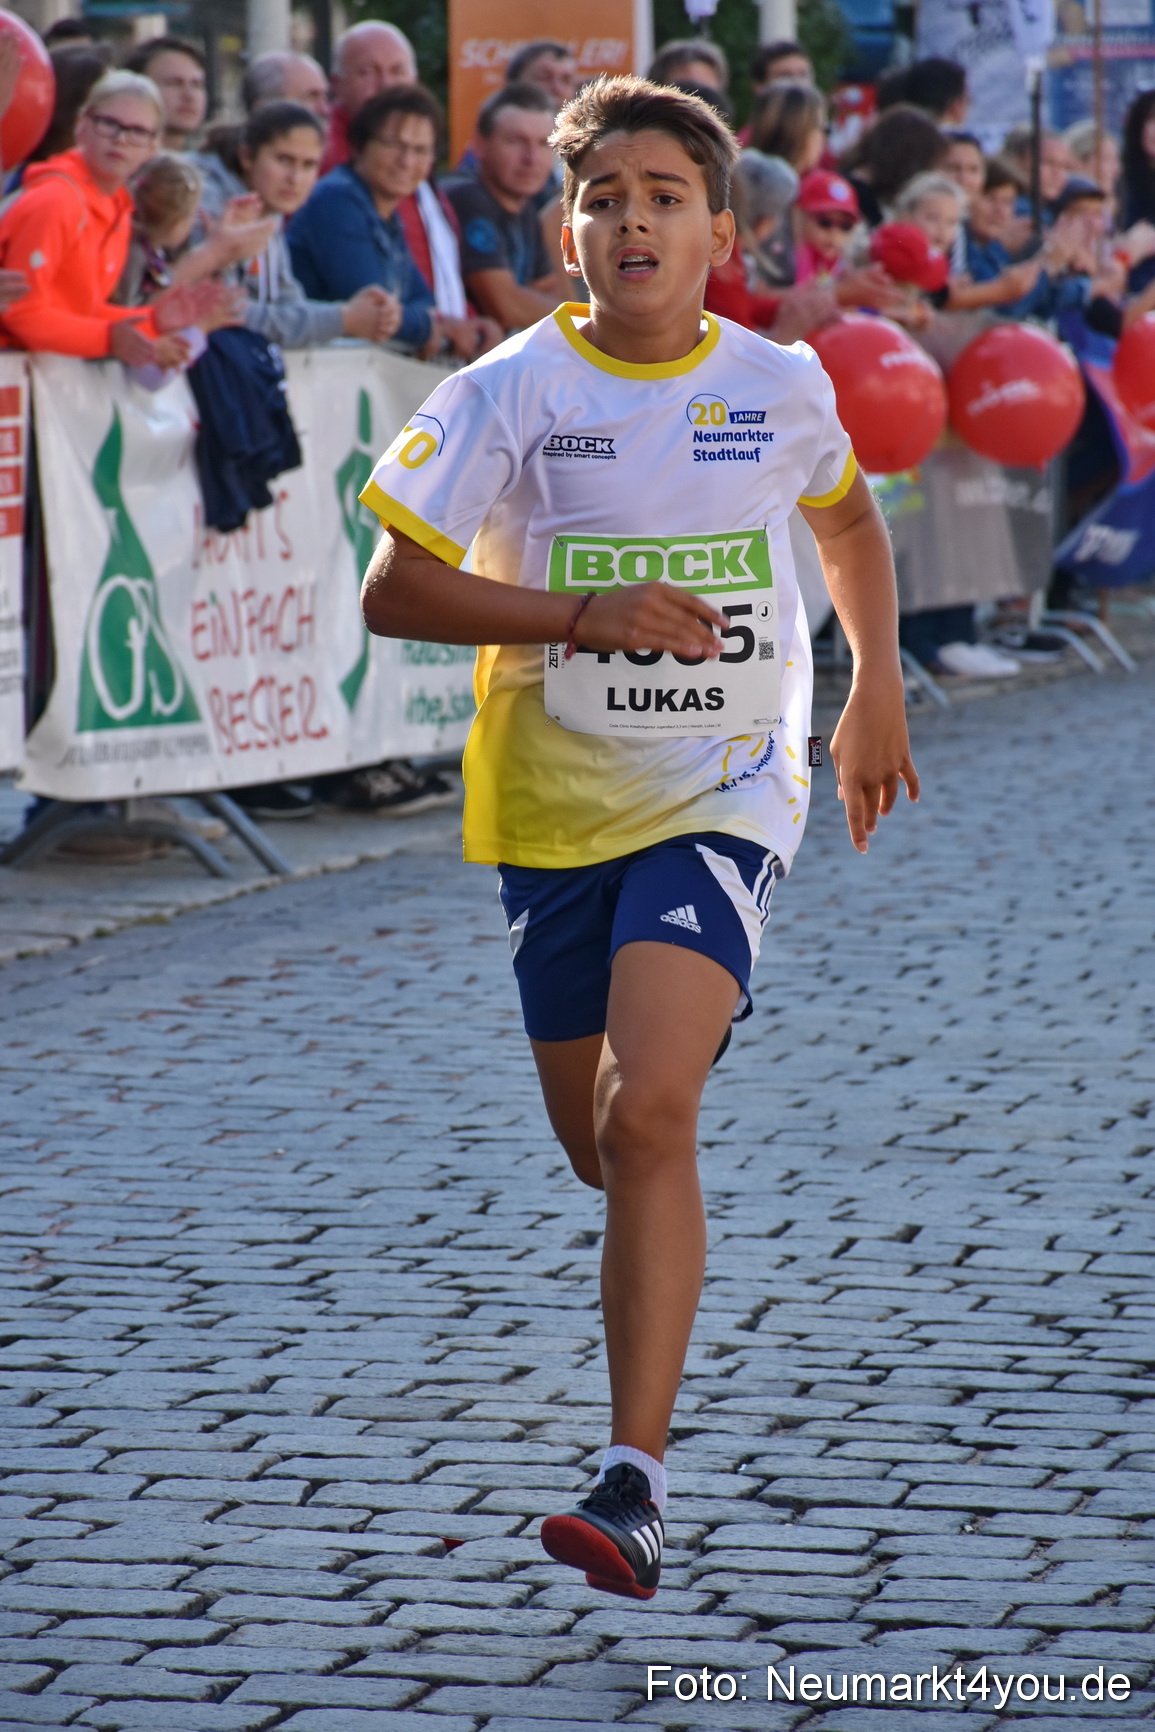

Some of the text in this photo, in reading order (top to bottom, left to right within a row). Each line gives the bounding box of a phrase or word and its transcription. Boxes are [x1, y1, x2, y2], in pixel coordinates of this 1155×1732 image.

[691, 402, 763, 426] 20 JAHRE
[543, 435, 616, 454] BOCK
[693, 429, 774, 443] Neumarkter
[693, 447, 761, 463] Stadtlauf
[566, 539, 758, 587] BOCK
[761, 606, 768, 617] J
[607, 687, 725, 712] LUKAS
[660, 914, 701, 934] adidas
